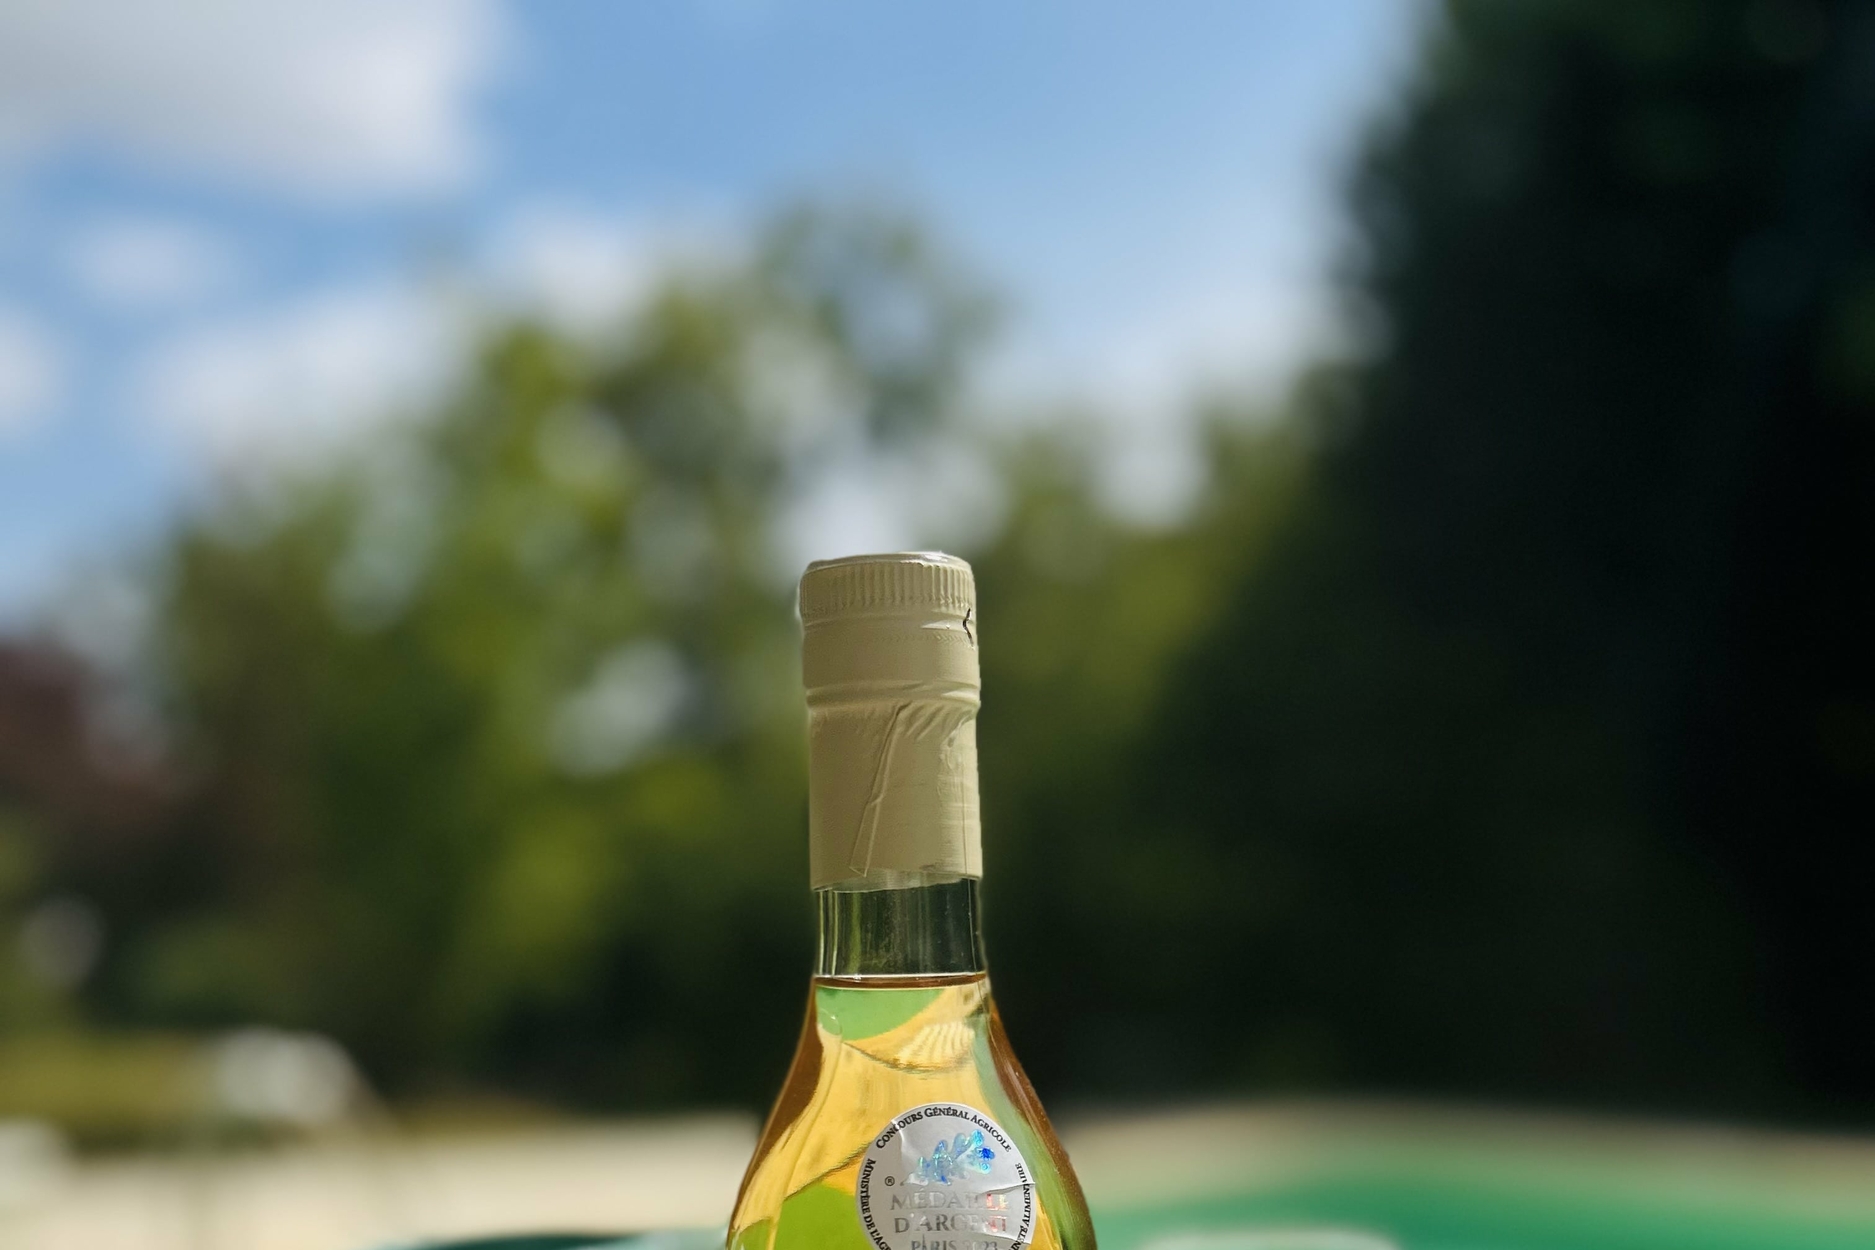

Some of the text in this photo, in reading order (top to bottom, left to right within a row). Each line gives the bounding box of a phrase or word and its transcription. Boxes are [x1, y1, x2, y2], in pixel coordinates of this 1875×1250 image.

[876, 1107, 1012, 1152] CONCOURS GÉNÉRAL AGRICOLE
[860, 1158, 876, 1215] MINISTÈRE
[864, 1214, 876, 1230] DE
